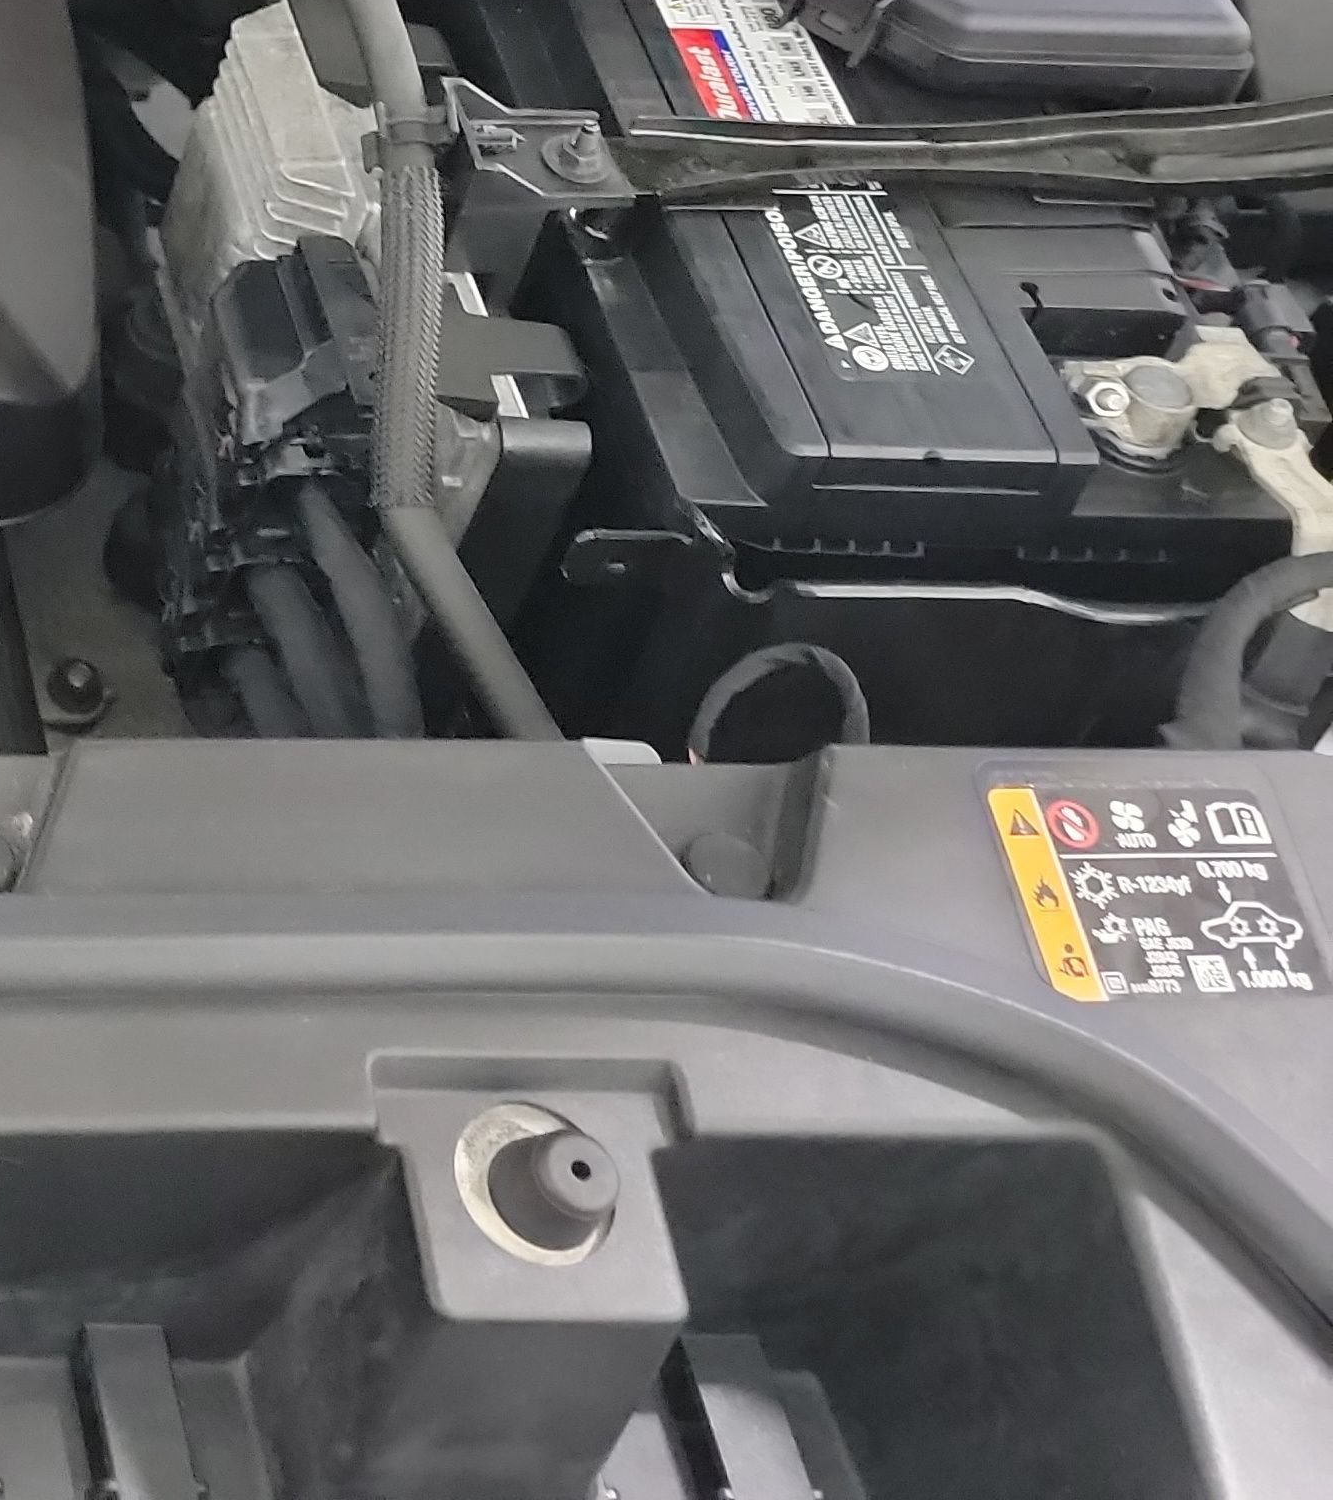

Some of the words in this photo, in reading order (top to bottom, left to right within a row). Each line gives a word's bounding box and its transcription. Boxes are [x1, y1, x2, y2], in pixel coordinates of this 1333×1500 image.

[764, 206, 840, 334] DANGER/POISO
[1116, 832, 1157, 849] AUTO
[1195, 860, 1242, 880] 0.700
[1243, 861, 1269, 882] kg
[1117, 874, 1193, 897] R-1234yf
[1131, 916, 1172, 937] PAG
[1236, 970, 1289, 989] 1.000
[1289, 971, 1315, 992] kg
